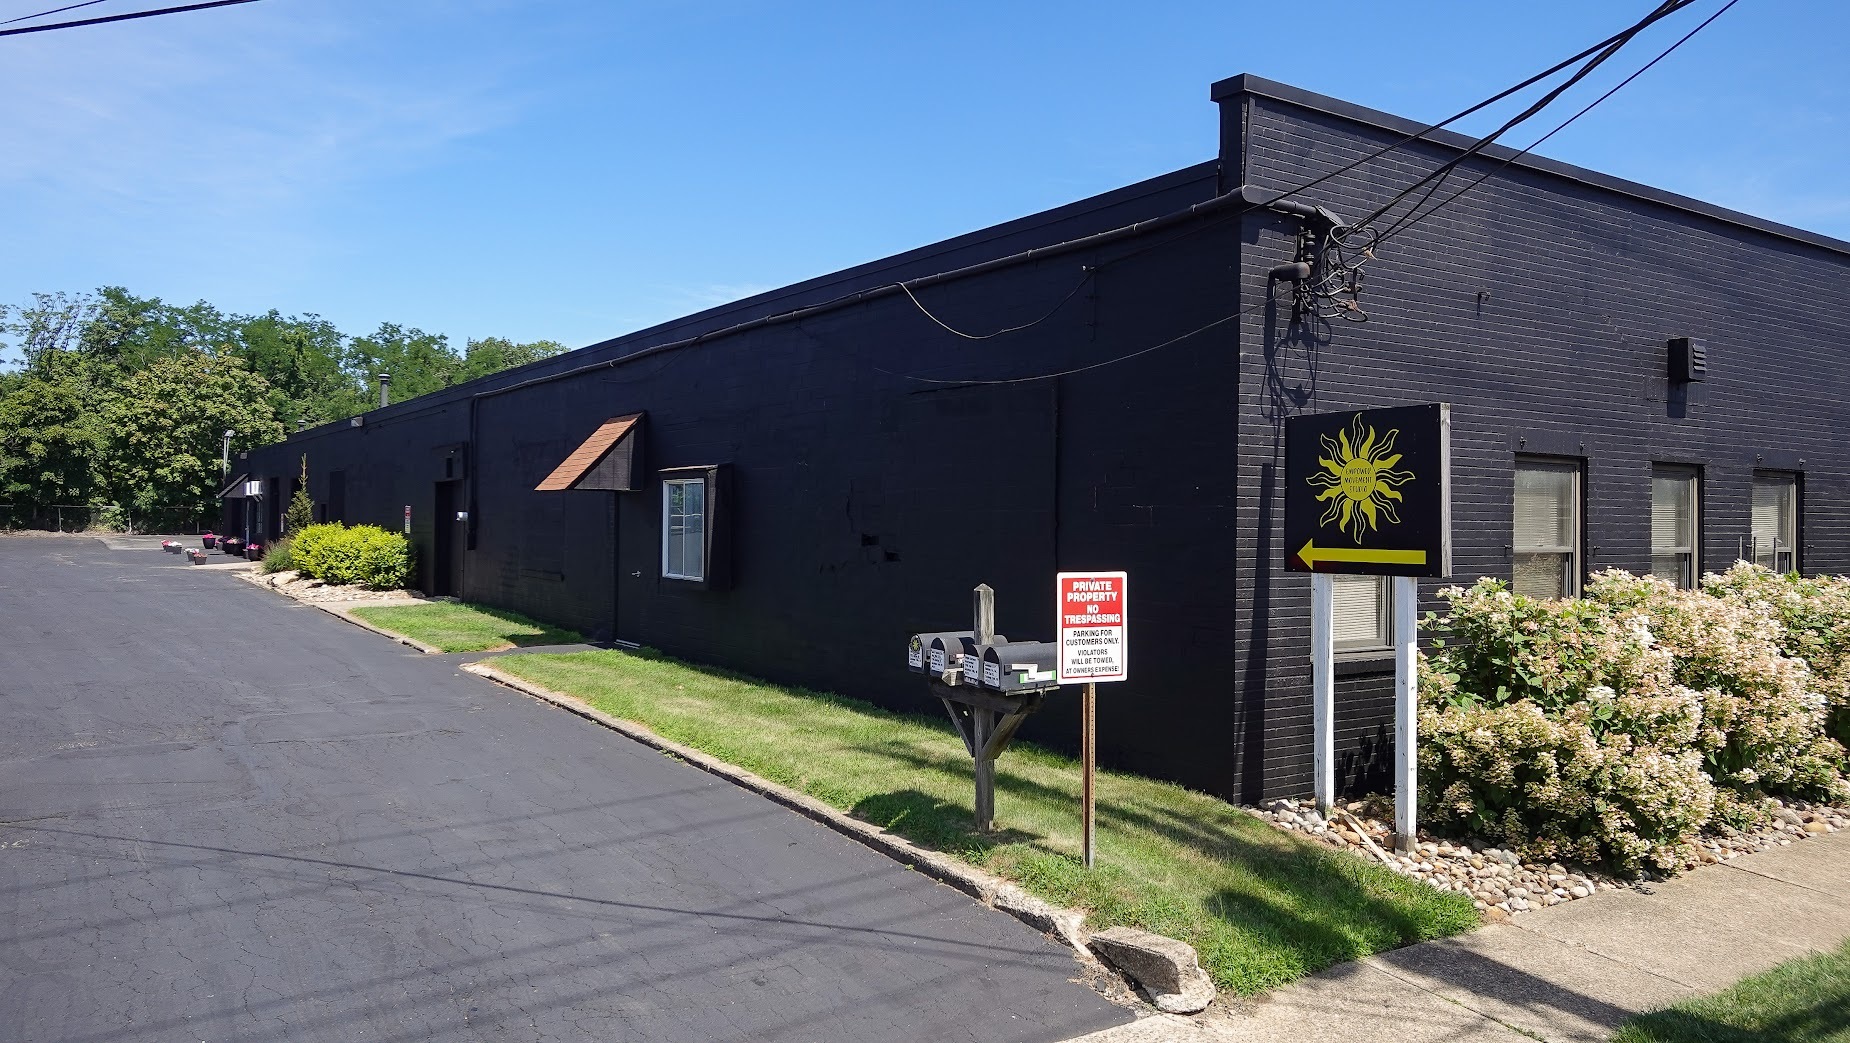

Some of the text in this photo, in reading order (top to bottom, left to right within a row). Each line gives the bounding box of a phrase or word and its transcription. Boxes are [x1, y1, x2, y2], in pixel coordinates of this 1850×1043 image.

[1073, 581, 1112, 591] PRIVATE
[1067, 592, 1118, 602] PROPERTY
[1087, 605, 1099, 614] NO
[1064, 614, 1121, 624] TRESPASSING
[1073, 629, 1113, 638] PARKING FOR
[1066, 638, 1103, 646] CUSTOMERS
